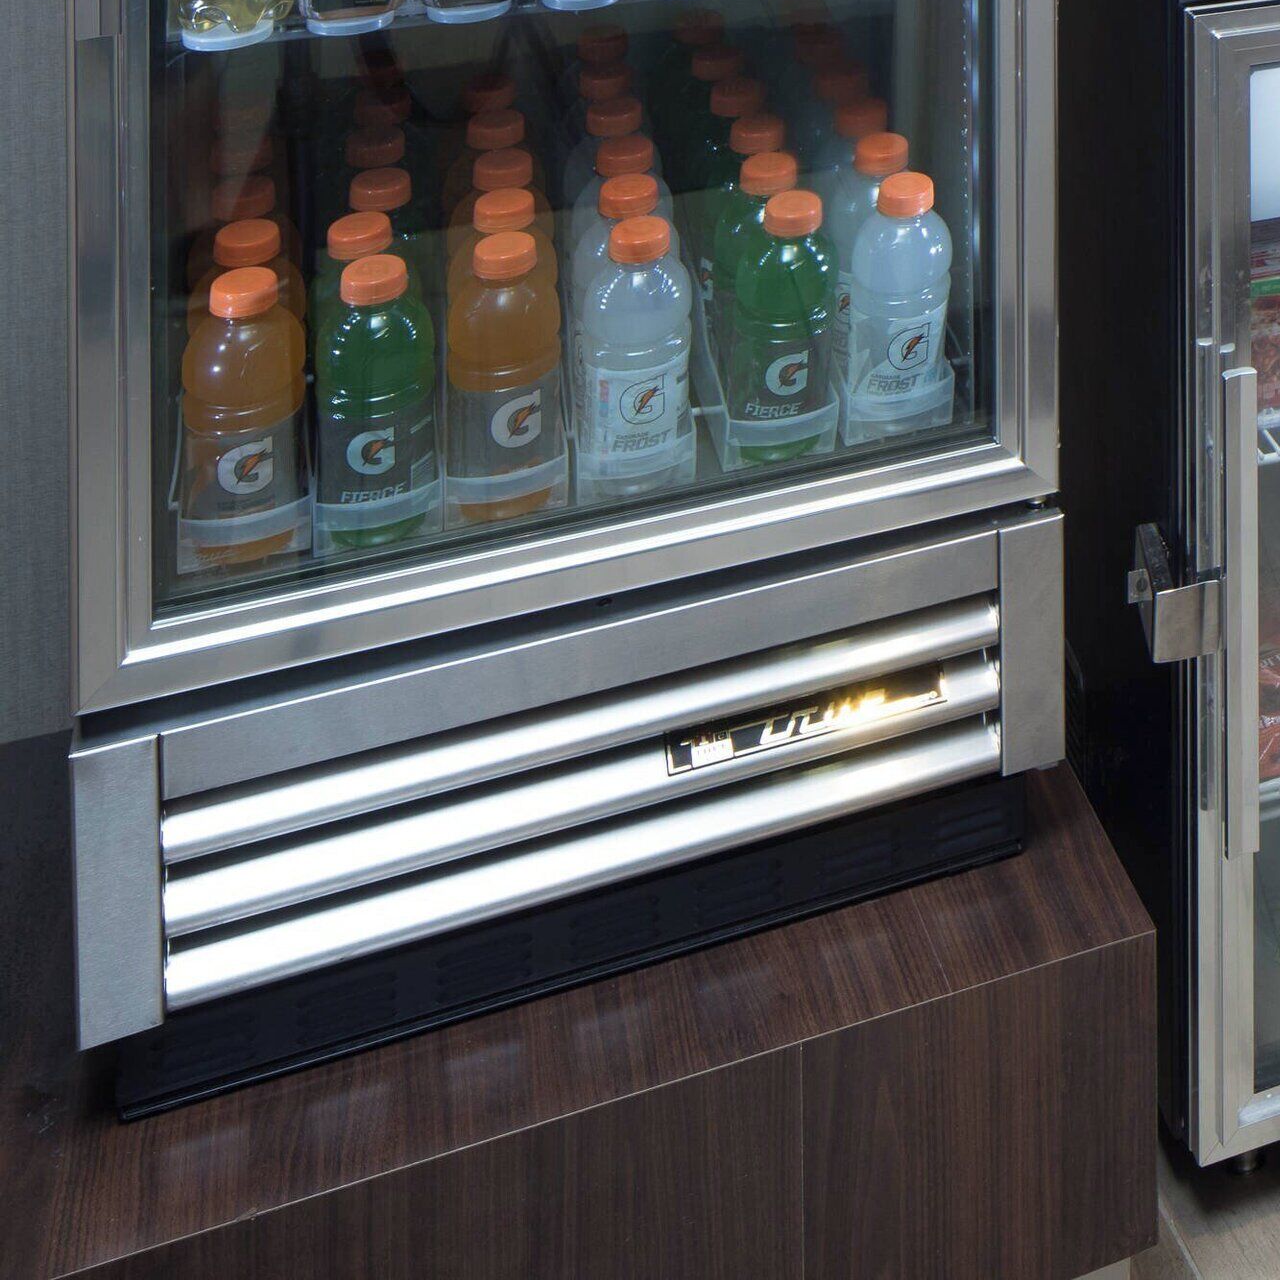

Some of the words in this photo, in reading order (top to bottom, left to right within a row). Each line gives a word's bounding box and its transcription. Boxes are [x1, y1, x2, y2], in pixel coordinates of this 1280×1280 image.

[887, 322, 931, 371] G
[764, 350, 809, 397] G
[867, 373, 922, 393] FROST
[490, 389, 542, 448] G
[619, 373, 667, 425] G
[744, 402, 802, 419] FIERCE
[217, 435, 274, 495] G
[346, 426, 395, 476] G
[611, 430, 671, 453] FROST
[339, 482, 405, 504] FIERCE
